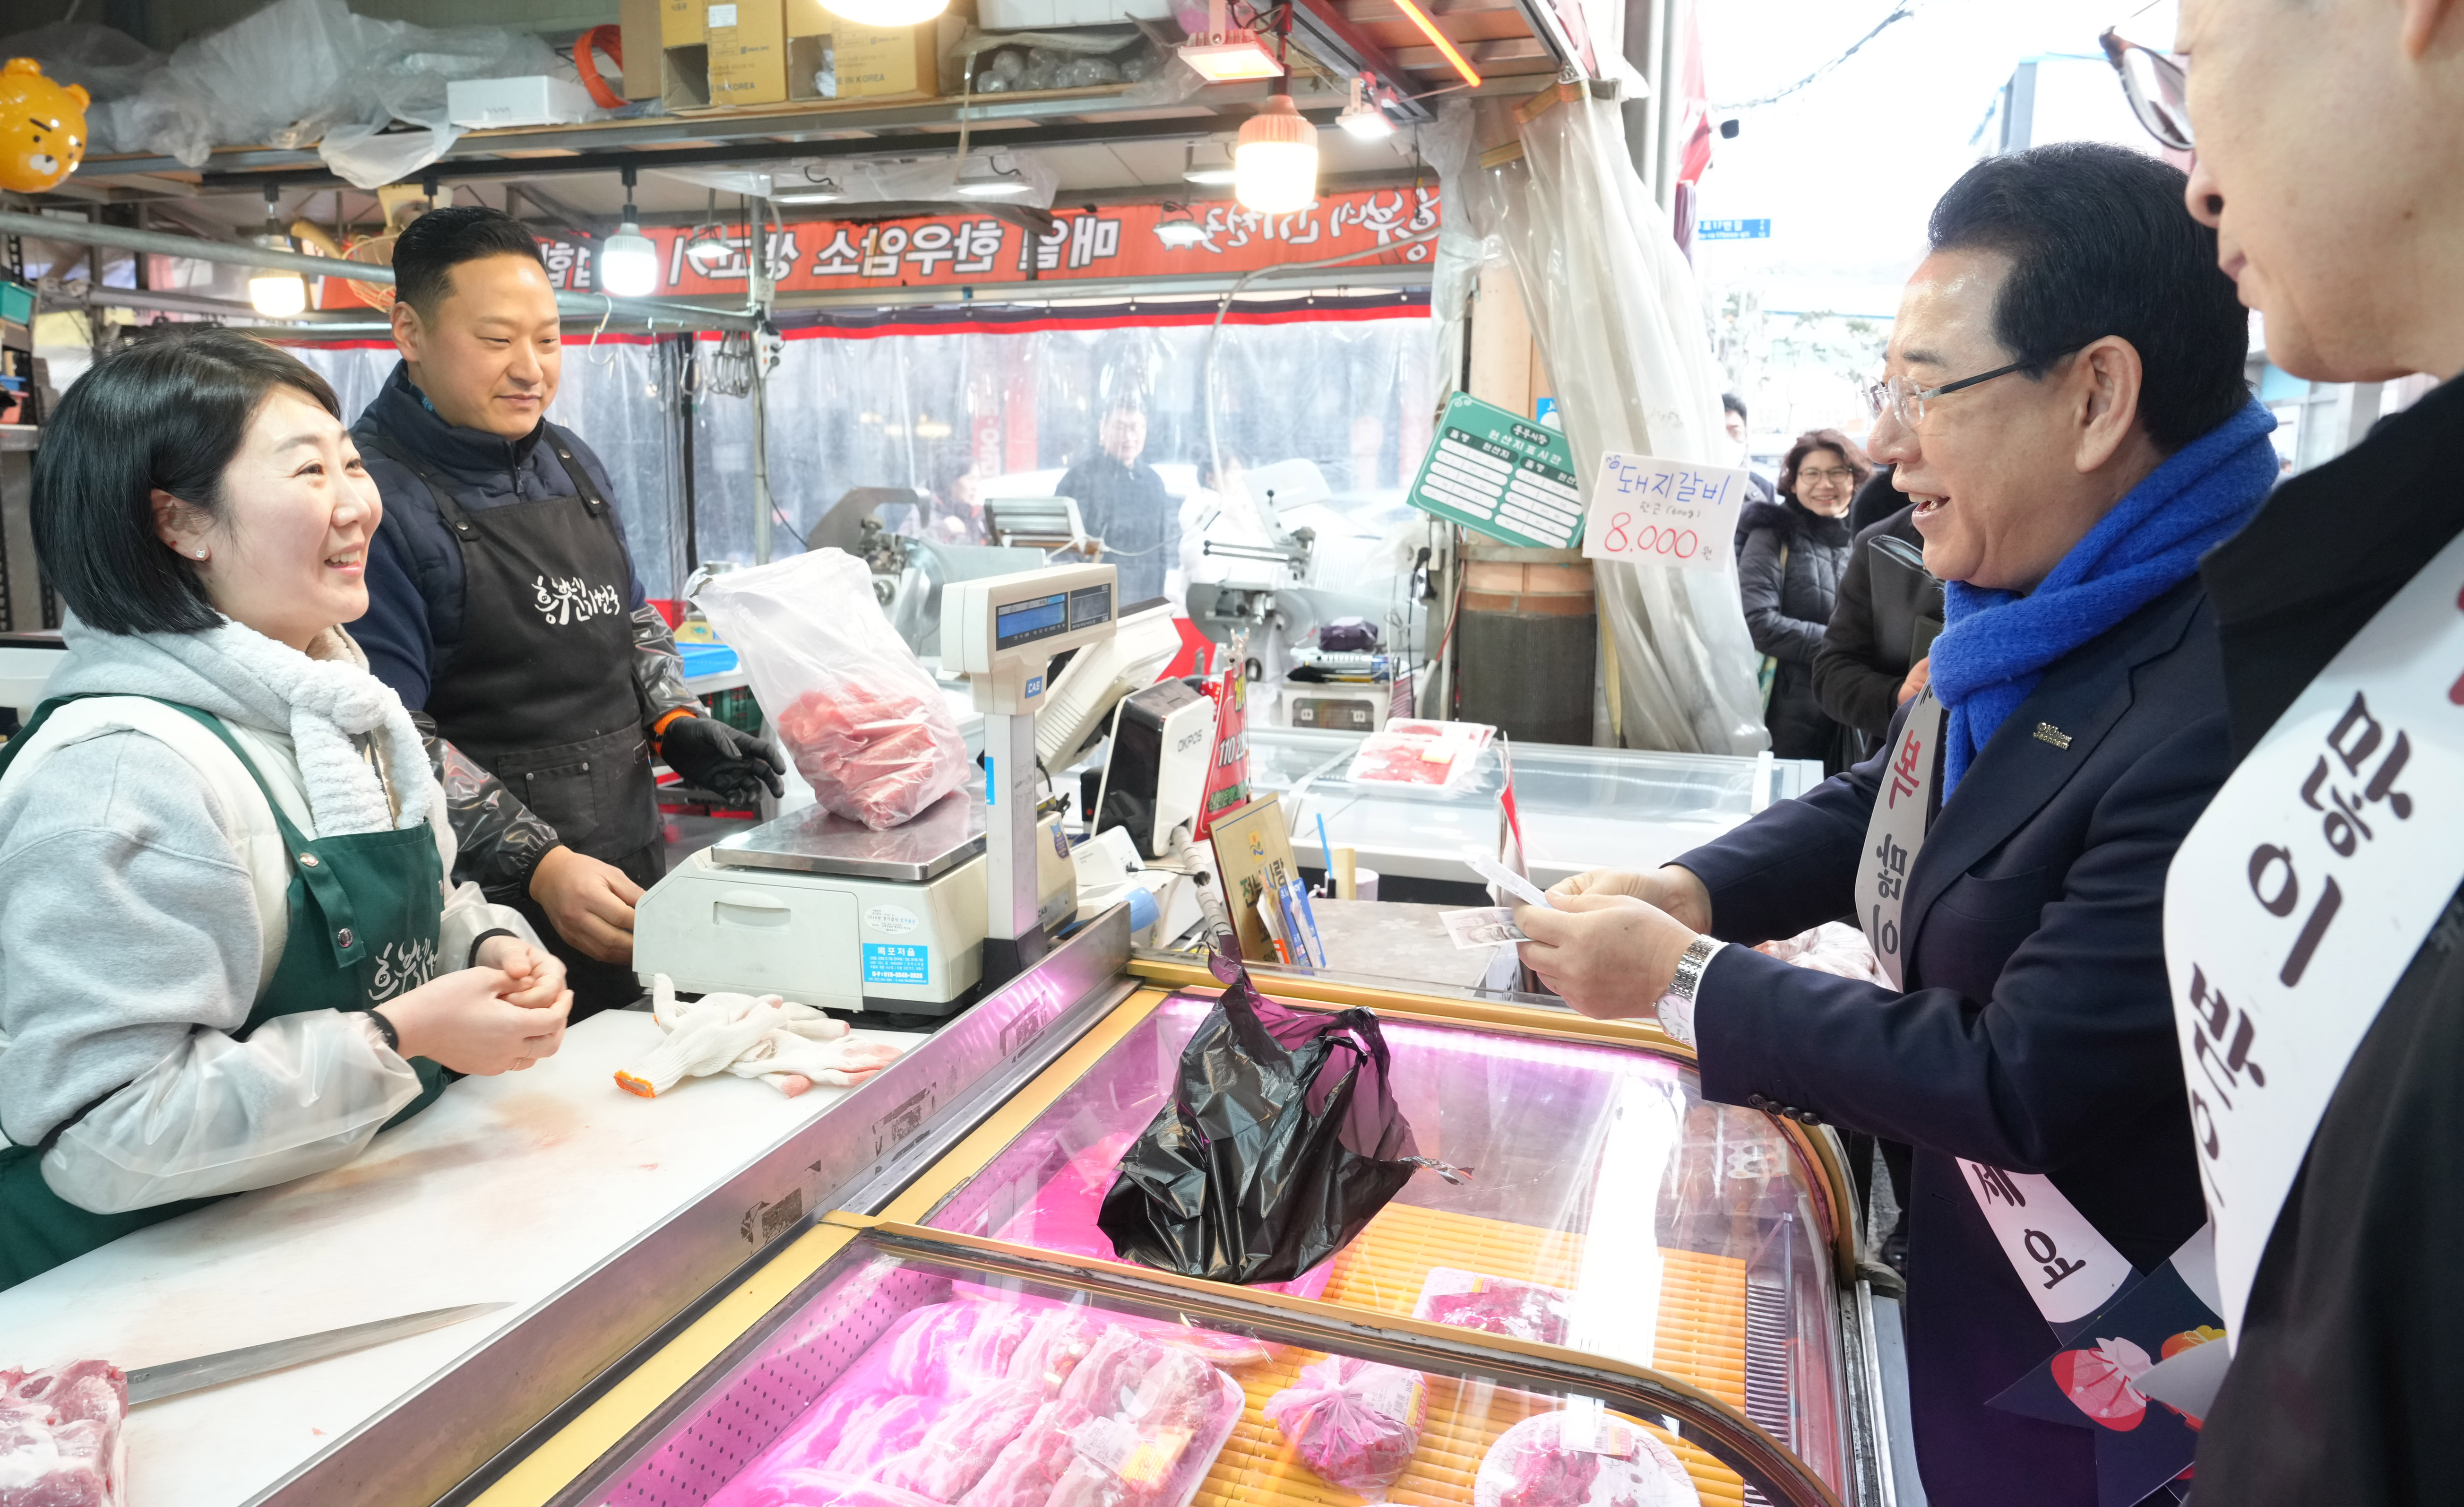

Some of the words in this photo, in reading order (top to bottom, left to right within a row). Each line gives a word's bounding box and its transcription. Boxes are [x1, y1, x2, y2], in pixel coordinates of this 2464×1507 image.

[856, 73, 886, 84] KOREA
[1616, 466, 1731, 505] 돼지갈비
[1605, 511, 1698, 559] 8.000
[1028, 679, 1041, 694] CAS
[1178, 729, 1202, 753] OKPOS
[1971, 1163, 2086, 1290] 세요
